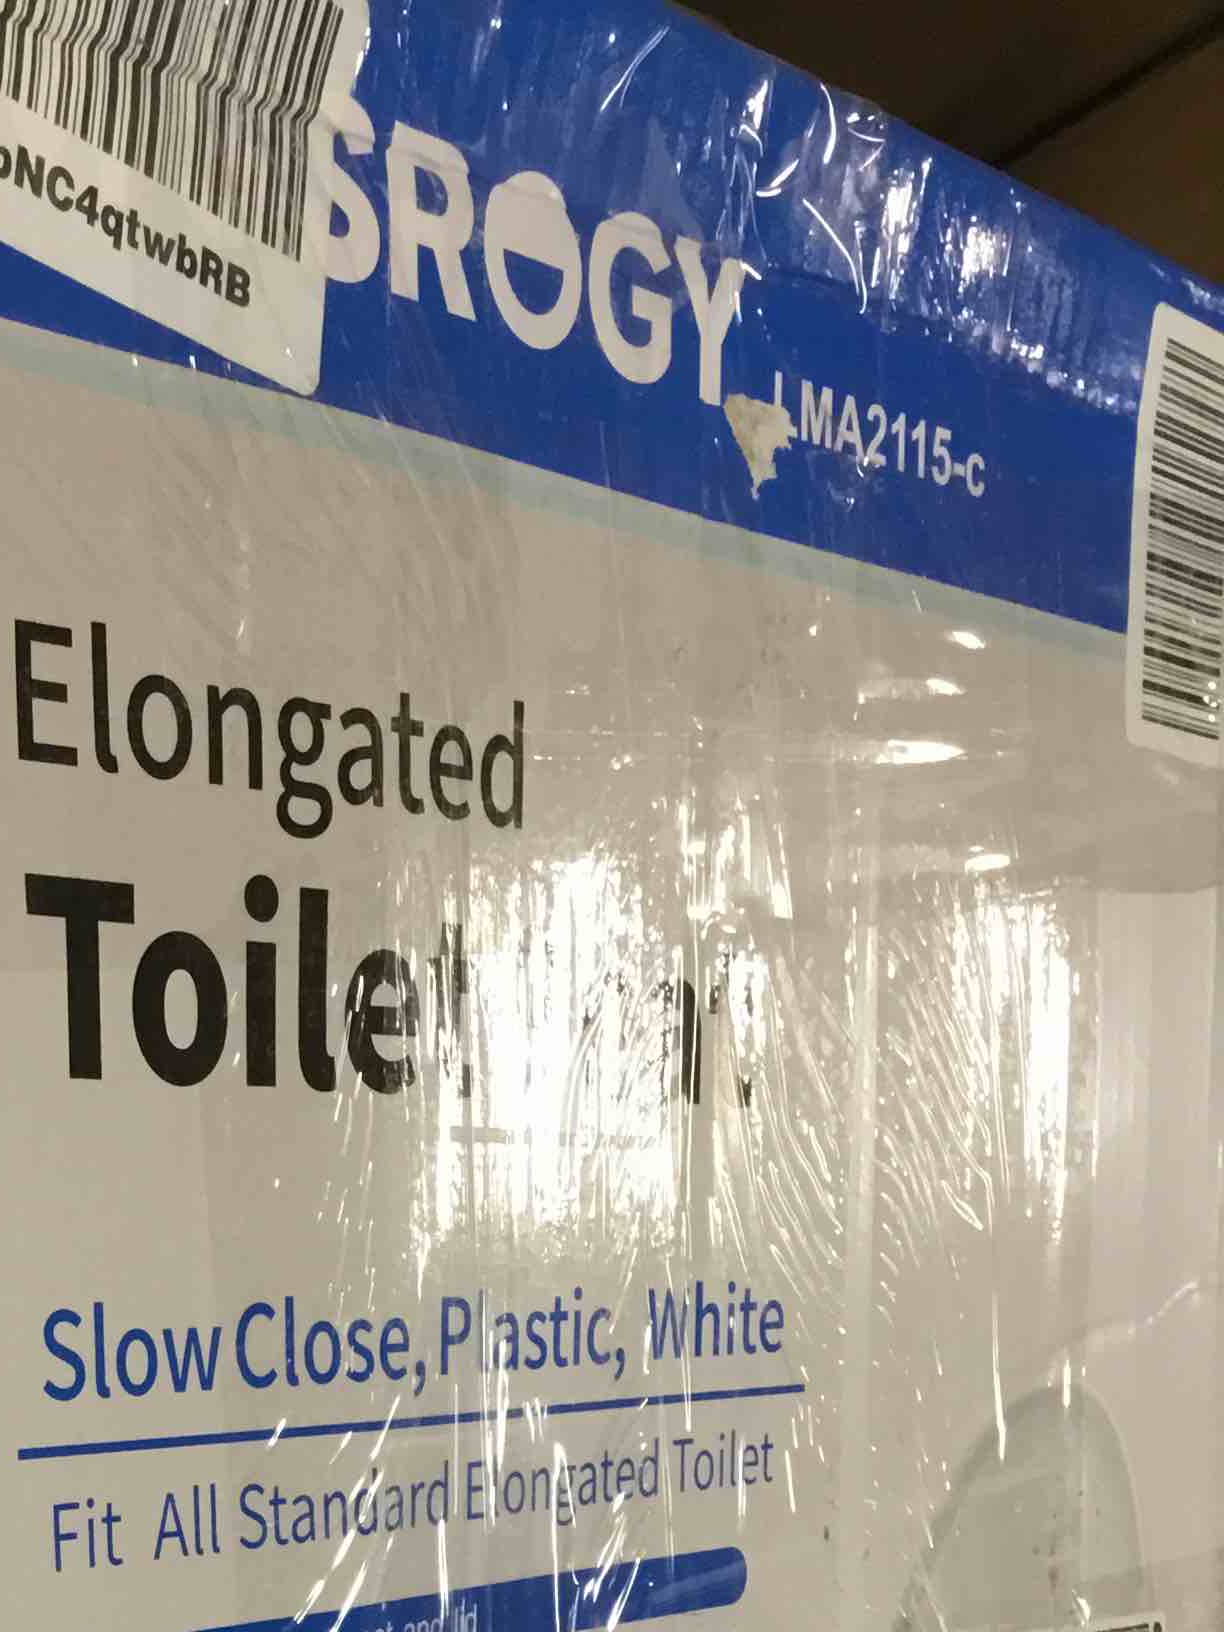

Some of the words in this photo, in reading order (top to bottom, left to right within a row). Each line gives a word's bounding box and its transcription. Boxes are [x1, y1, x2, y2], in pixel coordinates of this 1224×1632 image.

[14, 618, 525, 839] Elongated
[42, 1301, 222, 1401] Slow
[235, 1295, 426, 1397] Close,
[440, 1287, 627, 1381] Plastic,
[646, 1280, 785, 1360] White
[51, 1496, 123, 1572] Fit
[153, 1481, 221, 1561] All
[239, 1461, 449, 1552] Standard
[464, 1438, 660, 1528] Elongated
[672, 1432, 775, 1494] Toilet
